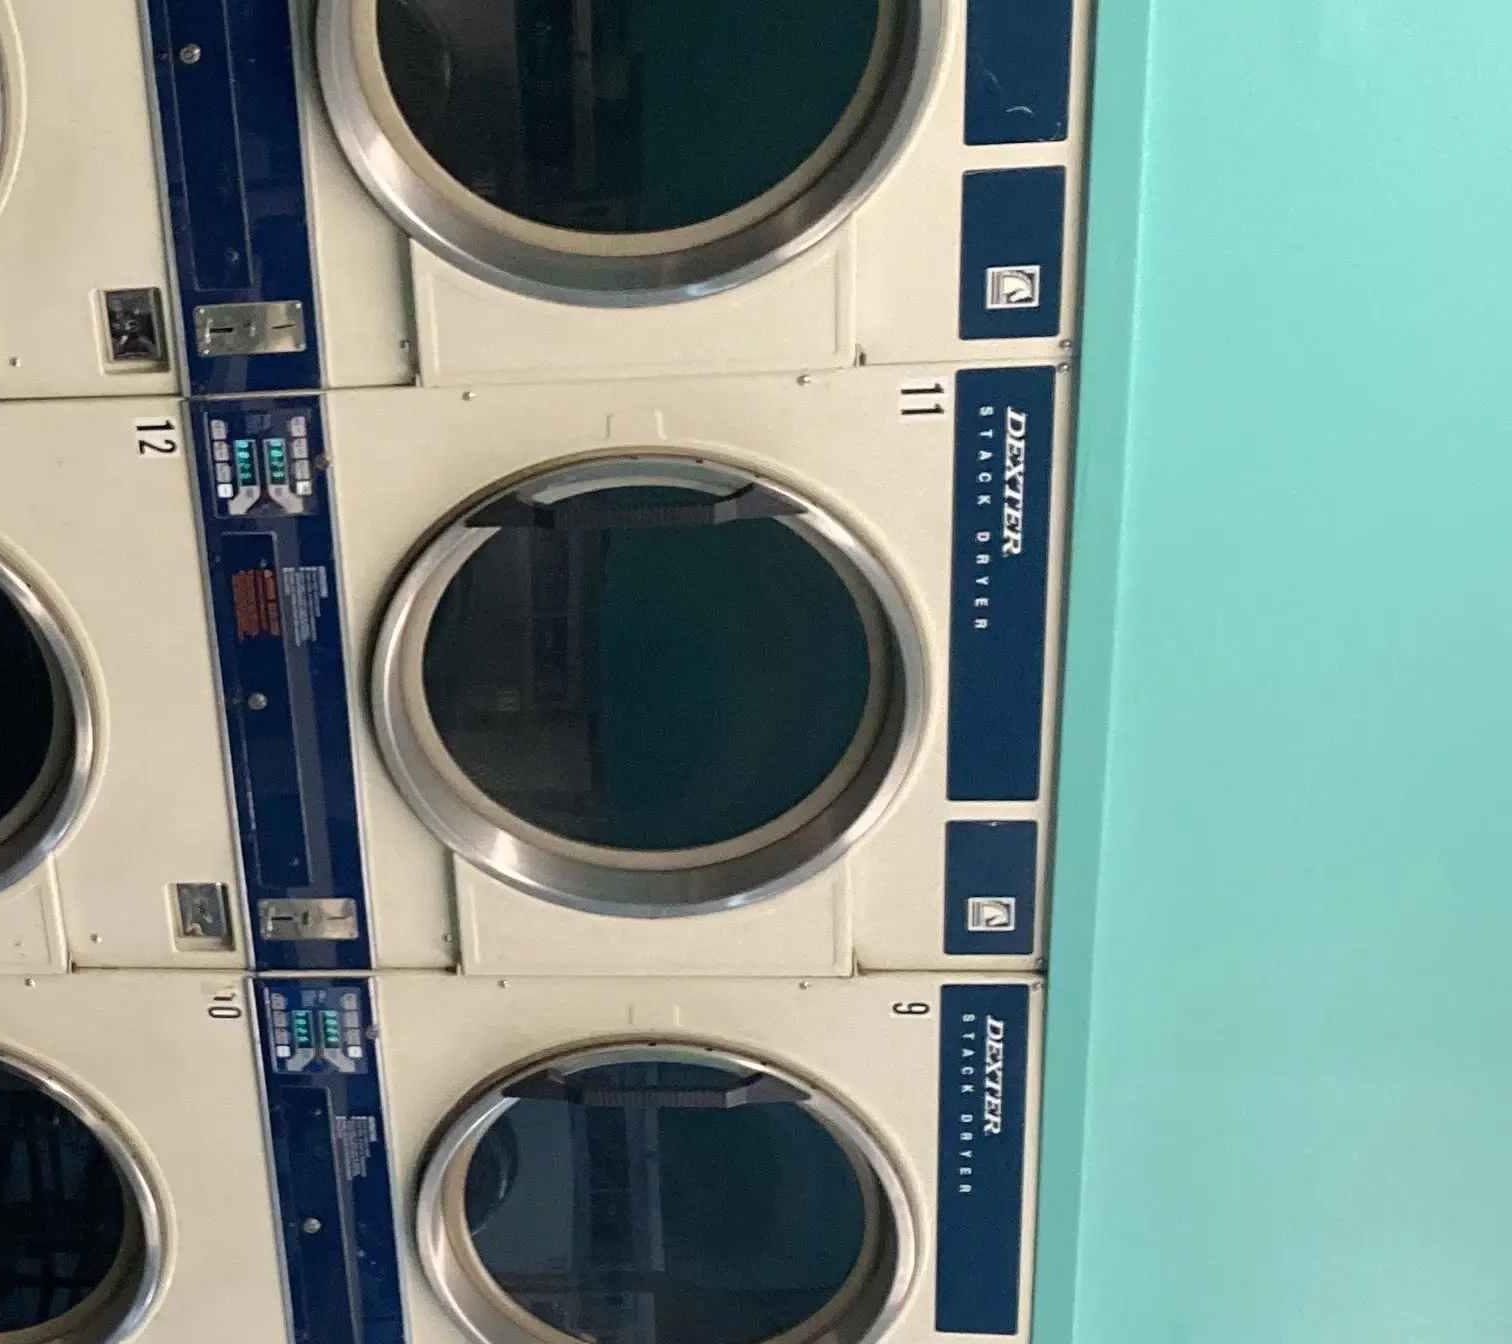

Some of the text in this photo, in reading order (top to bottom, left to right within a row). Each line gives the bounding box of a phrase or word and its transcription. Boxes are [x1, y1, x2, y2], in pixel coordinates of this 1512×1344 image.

[136, 420, 177, 455] 12
[900, 382, 944, 417] 11
[973, 406, 993, 630] STACK DRYER
[1002, 406, 1026, 557] DEXTER
[892, 1001, 929, 1017] 9
[958, 1014, 975, 1194] STACK DRYER
[983, 1014, 1004, 1135] DEXTER
